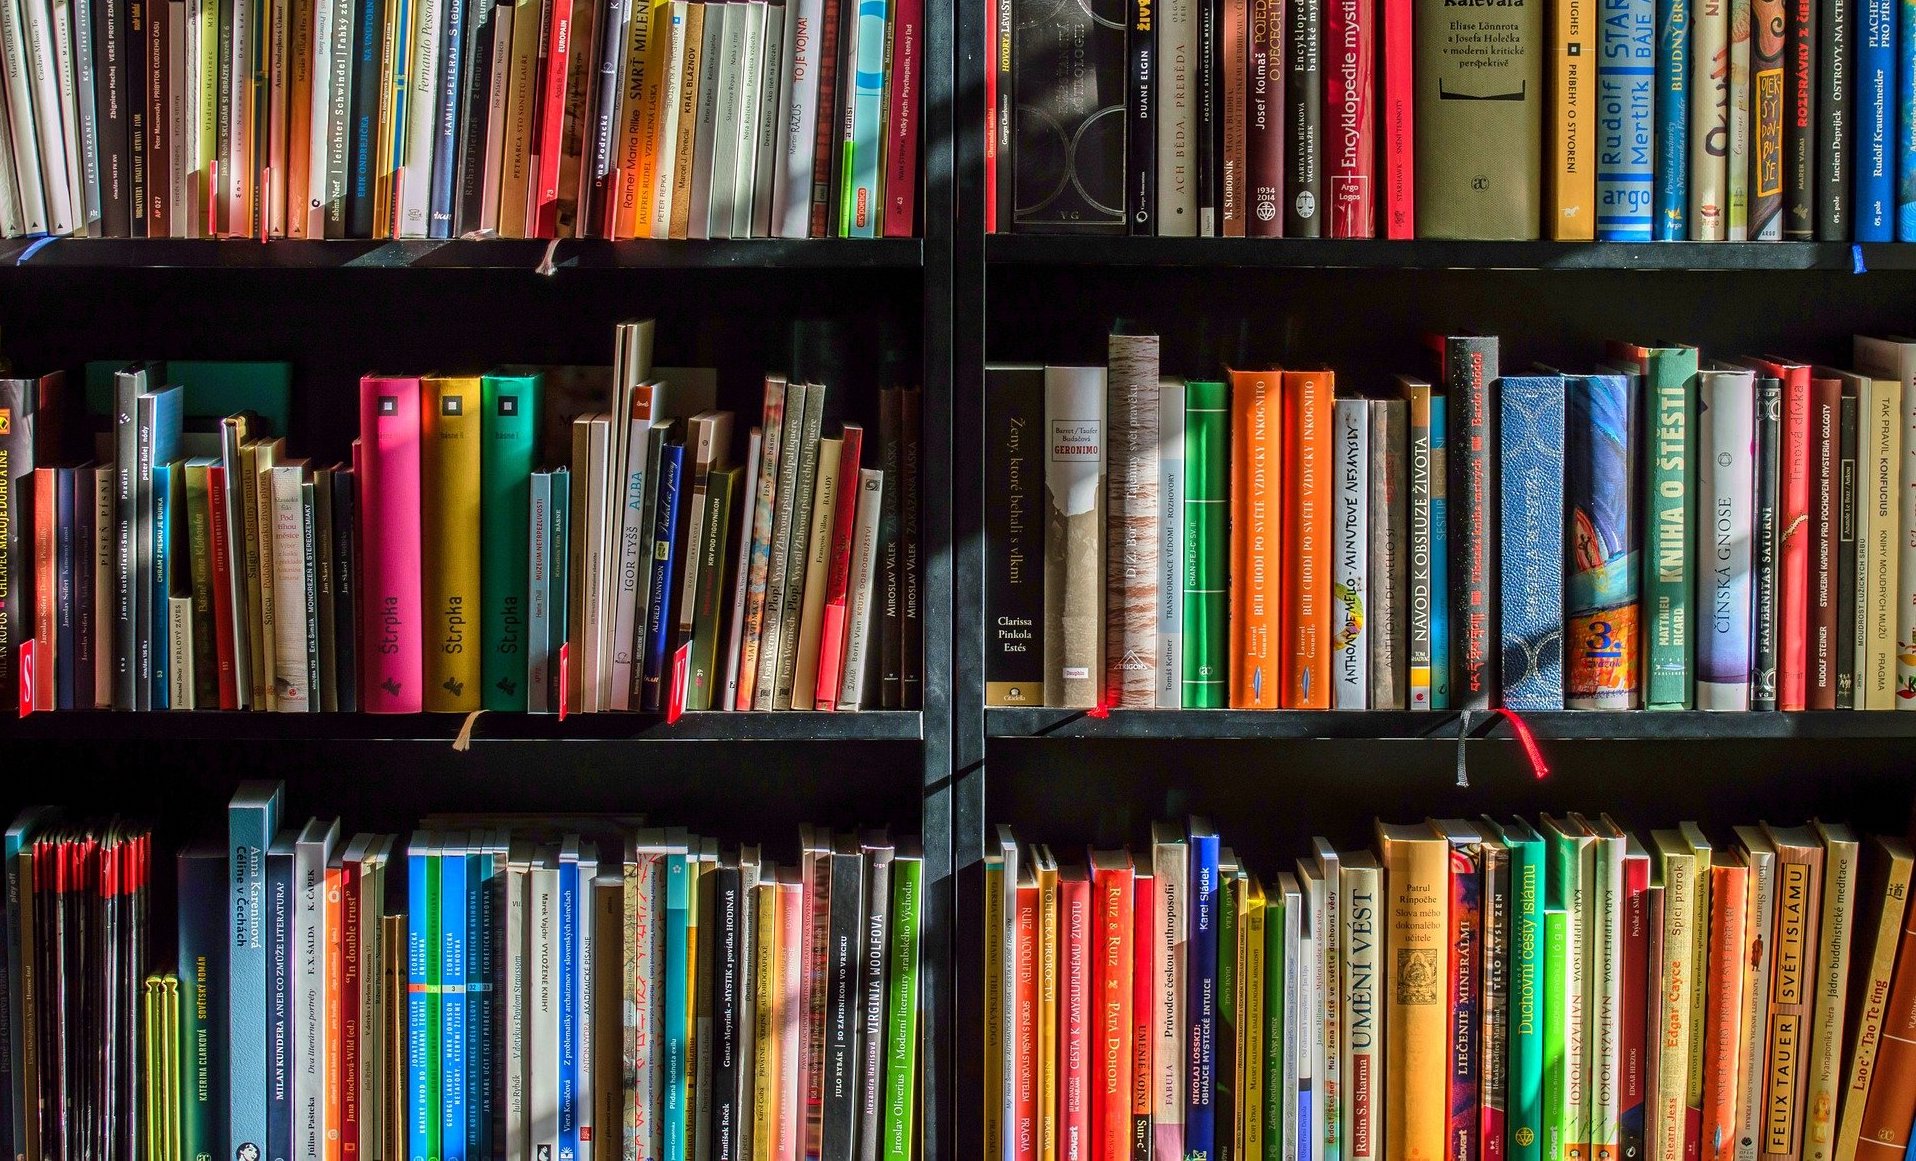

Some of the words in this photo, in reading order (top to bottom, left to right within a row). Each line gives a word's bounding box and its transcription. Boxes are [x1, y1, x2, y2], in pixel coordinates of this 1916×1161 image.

[421, 0, 434, 35] Pessoa
[559, 20, 567, 53] EUROPAIN
[796, 17, 808, 53] VOJNA!
[795, 57, 806, 66] JE
[904, 36, 912, 55] tenký
[1002, 38, 1010, 71] HOVORY
[1668, 28, 1682, 91] BLUDNÝ
[418, 39, 432, 93] Fernando
[447, 47, 456, 95] PETERAJ
[630, 58, 644, 100] SMRŤ
[685, 48, 696, 87] BLÁZNOV
[794, 68, 804, 82] TO
[1140, 51, 1148, 80] ELGIN
[1174, 45, 1185, 107] PŘEBĚDA
[1255, 53, 1265, 93] Kolmaš
[335, 59, 346, 115] Schwindel
[1140, 85, 1148, 118] DUANE
[1874, 70, 1883, 142] Krautschneider
[444, 102, 453, 135] KAMIL
[630, 110, 640, 134] Rilke
[900, 118, 909, 136] Veľký
[1256, 99, 1266, 129] Josef
[1341, 53, 1359, 167] Encyklopedie
[1568, 110, 1576, 118] O
[1601, 80, 1621, 164] Rudolf
[1631, 81, 1649, 164] Mertlík
[85, 115, 93, 157] MAZANEC
[334, 121, 343, 163] leichter
[359, 117, 369, 173] ONDREJIČKA
[598, 115, 608, 159] Podracká
[1174, 115, 1186, 157] BĚDA,
[1833, 111, 1842, 149] Deprijck
[627, 138, 638, 169] Maria
[1832, 151, 1840, 182] Lucien
[1874, 144, 1882, 176] Rudolf
[332, 180, 340, 197] Naef
[358, 176, 366, 197] ERIK
[596, 164, 604, 187] Dana
[623, 173, 634, 208] Rainer
[1176, 165, 1185, 193] ACH
[331, 200, 340, 221] Sabina
[1603, 190, 1650, 212] argo
[1127, 384, 1138, 426] pravěku
[1127, 430, 1138, 451] svět
[1657, 387, 1684, 470] ŠTĚSTÍ
[141, 447, 149, 462] šulej
[1055, 446, 1098, 454] GERONIMO
[1412, 436, 1427, 494] ŽIVOTA
[100, 479, 108, 516] PÍSNÍ
[629, 472, 641, 510] ALBA
[822, 475, 832, 505] BALADY
[1660, 481, 1684, 498] O
[710, 498, 719, 537] FIGOVNÍKOM
[819, 514, 828, 533] Villon
[1415, 498, 1427, 565] OBSLUZE
[1718, 497, 1731, 560] GNOSE
[1761, 507, 1771, 563] SATURNI
[100, 526, 108, 565] PÍSEŇ
[626, 526, 637, 556] TYŠŠ
[816, 536, 826, 563] François
[887, 543, 896, 569] VÁLEK
[1660, 507, 1683, 582] KNIHA
[624, 561, 635, 591] IGOR
[654, 566, 663, 603] TENNYSON
[887, 571, 896, 617] MIROSLAV
[1415, 570, 1427, 579] K
[652, 605, 660, 632] ALFRED
[1413, 586, 1427, 640] NÁVOD
[1714, 567, 1730, 633] ČÍNSKÁ
[1760, 567, 1770, 653] FRATERNITAS
[379, 597, 401, 654] Štrpka
[441, 597, 465, 653] Štrpka
[496, 597, 520, 653] Štrpka
[998, 617, 1032, 625] Clarissa
[999, 630, 1032, 638] Pinkola
[1660, 597, 1669, 645] MATTHIEU
[1674, 608, 1684, 645] RICARD
[1004, 643, 1026, 651] Estés
[1164, 668, 1172, 691] Tomáš
[306, 869, 314, 899] ČAPEK
[1200, 868, 1209, 901] Sládek
[1520, 865, 1535, 915] islámu
[1836, 859, 1848, 903] meditace
[276, 882, 284, 941] LITERATURA?
[308, 901, 314, 911] K.
[902, 882, 912, 922] Východu
[1165, 884, 1175, 951] anthroposofií
[1200, 905, 1209, 929] Karel
[1347, 889, 1372, 954] VÉST
[1784, 870, 1801, 943] ISLÁMU
[870, 915, 882, 975] WOOLFOVÁ
[901, 926, 910, 971] arabského
[1522, 919, 1537, 959] cesty
[1829, 907, 1843, 968] buddhistické
[197, 956, 206, 981] ROMÁN
[275, 944, 284, 976] ZMŮŽE
[1164, 955, 1174, 988] českou
[1457, 921, 1469, 1004] MINERÁLMI
[1781, 952, 1796, 998] SVĚT
[276, 978, 283, 990] CO
[898, 974, 910, 1016] literatury
[1519, 964, 1534, 1034] Duchovní
[1668, 961, 1681, 1002] Cayce
[1828, 972, 1838, 998] Jádro
[197, 984, 207, 1019] SOVĚTSKÝ
[868, 981, 880, 1033] VIRGINIA
[1164, 991, 1173, 1037] Průvodce
[1347, 962, 1372, 1049] UMĚNÍ
[197, 1029, 207, 1065] CLARKOVÁ
[897, 1020, 907, 1059] Moderní
[1193, 1024, 1201, 1064] LOSSKIJ:
[1456, 1011, 1468, 1074] LIEČENIE
[1665, 1008, 1680, 1047] Edgar
[1776, 1023, 1792, 1086] TAUER
[199, 1068, 207, 1100] KATERINA
[895, 1074, 905, 1116] Oliverius
[1357, 1059, 1367, 1101] Sharma
[1357, 1105, 1366, 1115] S.
[1773, 1096, 1787, 1146] FELIX
[893, 1119, 903, 1155] Jaroslav
[1357, 1118, 1367, 1152] Robin
